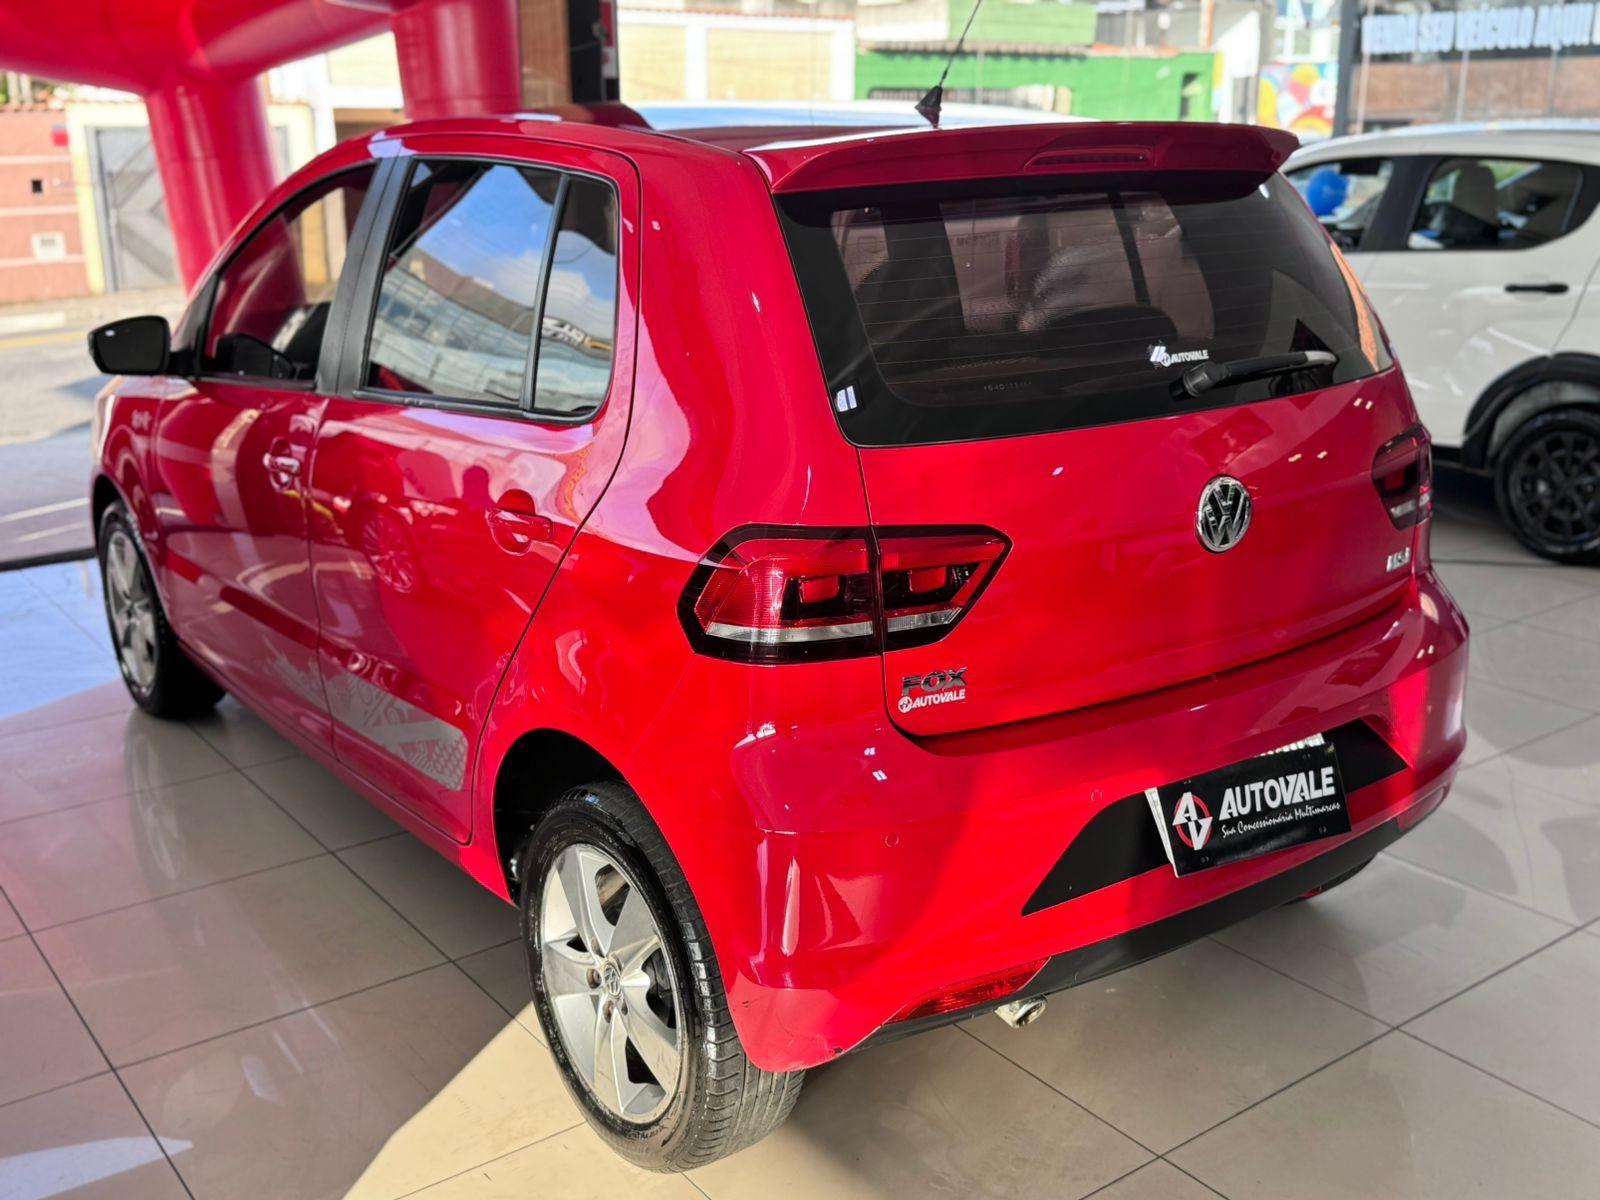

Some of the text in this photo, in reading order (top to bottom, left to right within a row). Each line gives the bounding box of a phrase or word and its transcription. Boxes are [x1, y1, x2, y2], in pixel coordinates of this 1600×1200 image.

[1171, 349, 1210, 364] AUTOVALE
[902, 666, 968, 697] FOX
[911, 689, 966, 708] AUTOVALE
[1219, 767, 1335, 821] AUTOVALE
[1221, 823, 1236, 838] Sua
[1294, 802, 1340, 820] Multimarcas
